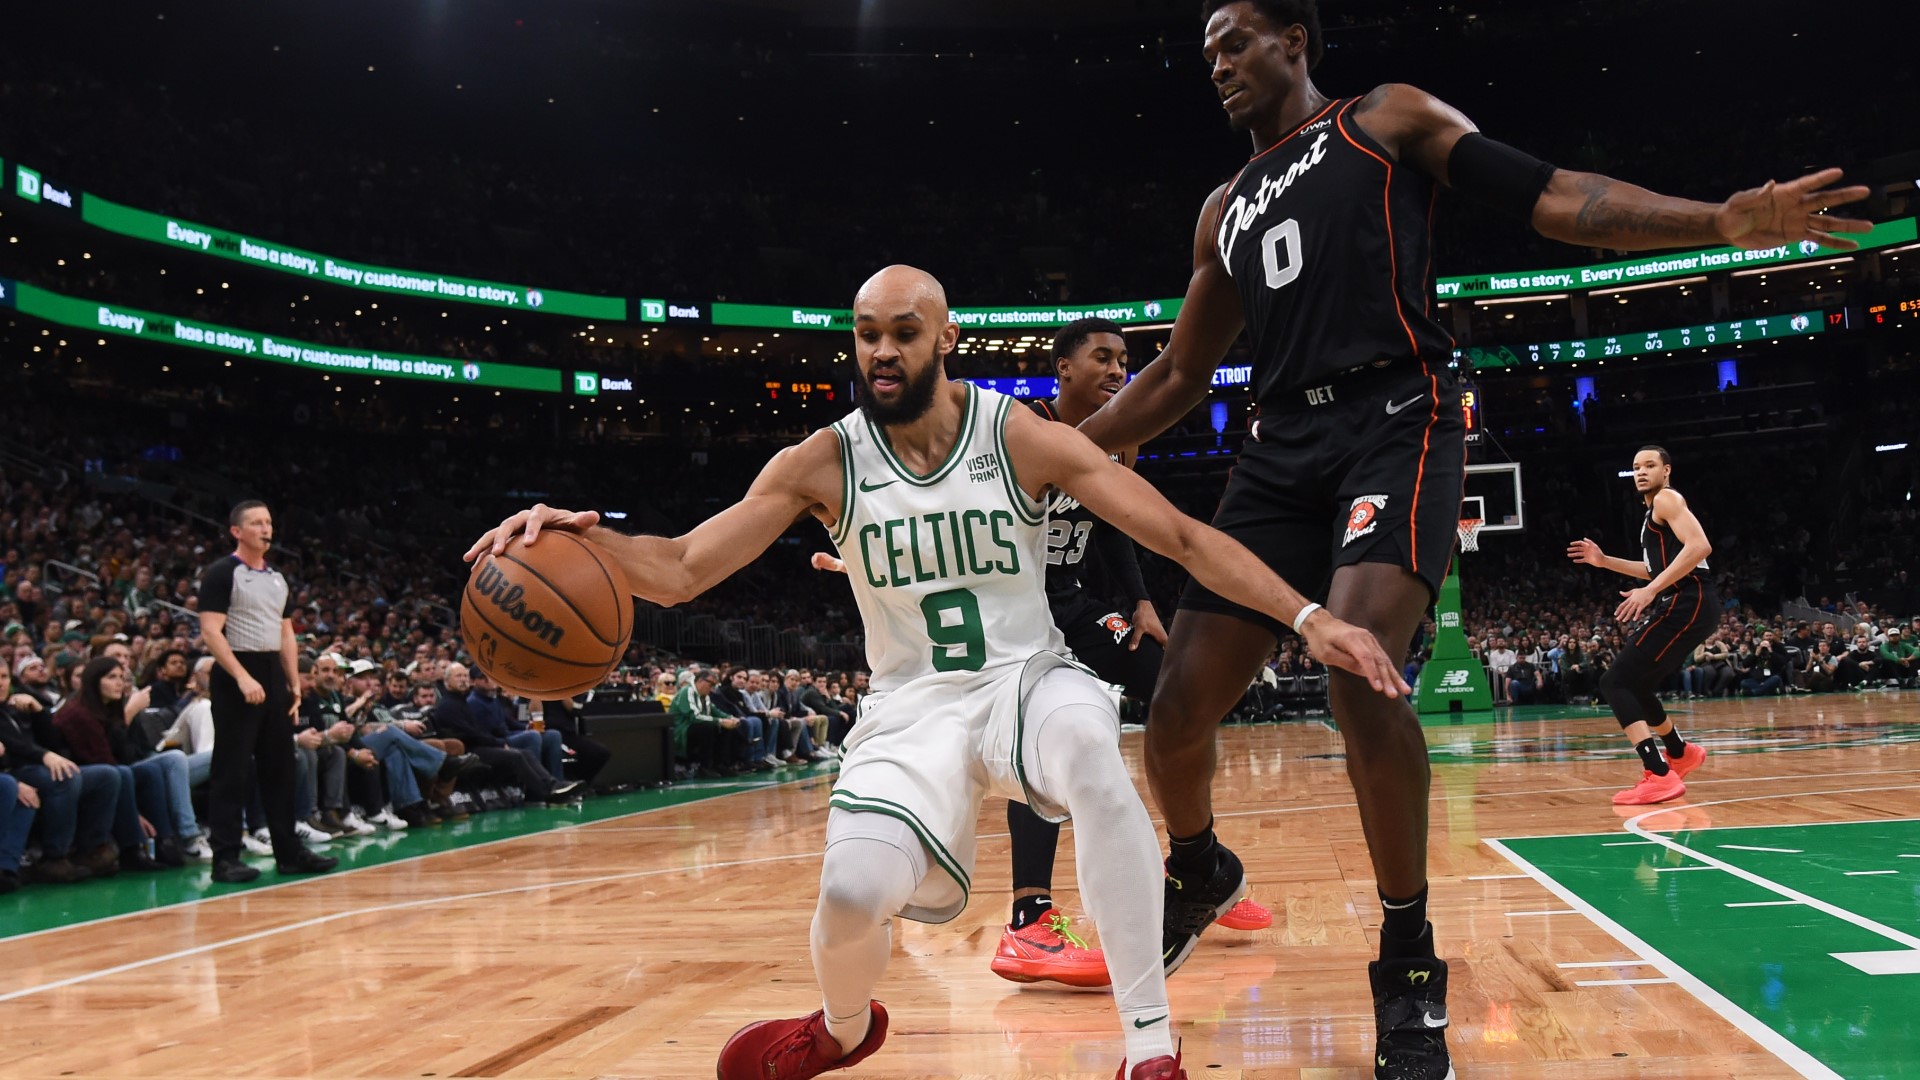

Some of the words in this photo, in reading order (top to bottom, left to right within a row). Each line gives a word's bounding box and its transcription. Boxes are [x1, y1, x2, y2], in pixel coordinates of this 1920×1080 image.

[1300, 118, 1331, 134] UWM
[18, 170, 39, 195] TD
[1218, 132, 1328, 277] Detroit
[167, 221, 211, 249] Every
[214, 236, 240, 252] win
[241, 239, 267, 260] has
[269, 250, 279, 263] a
[280, 252, 319, 274] story.
[325, 260, 362, 285] Every
[364, 272, 437, 292] customer
[438, 278, 465, 296] has
[467, 285, 477, 297] a
[478, 286, 518, 304] story.
[1262, 218, 1302, 289] 0
[1436, 282, 1460, 295] ery
[1463, 279, 1489, 291] win
[1491, 277, 1519, 290] has
[1520, 277, 1530, 287] a
[1532, 274, 1573, 286] story.
[1581, 266, 1623, 282] Every
[1626, 256, 1698, 276] customer
[1701, 252, 1730, 267] has
[1732, 251, 1742, 262] a
[1745, 246, 1790, 260] story.
[642, 303, 663, 318] TD
[669, 305, 699, 318] Bank
[792, 310, 831, 327] Every
[948, 311, 987, 325] Every
[989, 311, 1056, 323] customer
[1057, 309, 1082, 322] has
[1096, 307, 1136, 320] story.
[1829, 314, 1842, 324] 17
[1876, 314, 1883, 323] 6
[98, 307, 144, 334] Every
[148, 320, 174, 336] win
[175, 321, 203, 342] has
[204, 331, 215, 344] a
[216, 332, 256, 354] story.
[262, 338, 300, 362] Every
[302, 349, 371, 369] customer
[372, 354, 400, 371] has
[402, 360, 412, 372] a
[414, 360, 455, 379] story.
[1532, 352, 1538, 362] 0
[1552, 351, 1559, 360] 7
[1573, 349, 1585, 358] 40
[1604, 345, 1621, 355] 2/5
[1645, 340, 1662, 350] 0/3
[1683, 336, 1690, 345] 0
[1708, 334, 1715, 342] 0
[1734, 330, 1741, 339] 2
[1761, 327, 1766, 336] 1
[576, 375, 596, 391] TD
[602, 378, 632, 390] Bank
[1211, 366, 1252, 385] ETROIT
[1014, 387, 1030, 395] 0/0
[1305, 385, 1335, 406] DET
[966, 453, 997, 472] VISTA
[970, 467, 999, 483] PRINT
[860, 510, 1020, 588] CELTICS
[1048, 520, 1093, 565] 23
[475, 561, 565, 648] Wilson
[1441, 612, 1459, 621] VISTA
[920, 588, 987, 672] 9
